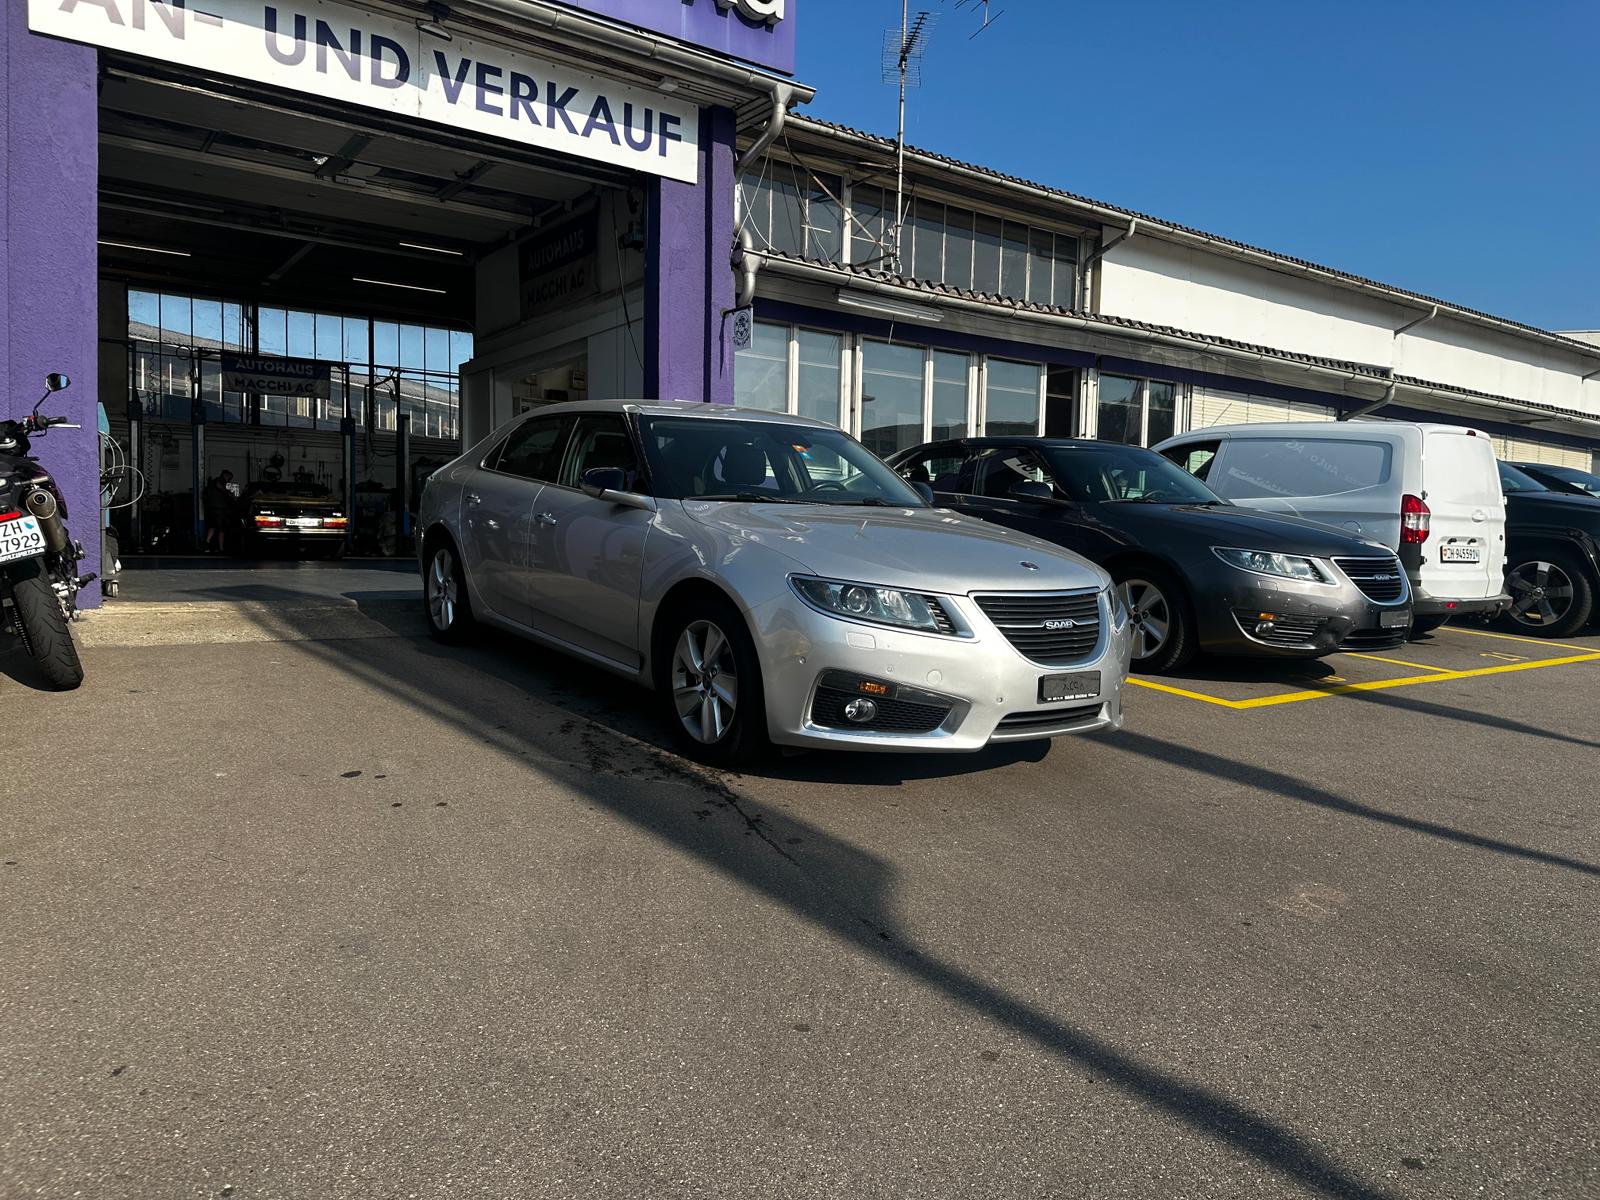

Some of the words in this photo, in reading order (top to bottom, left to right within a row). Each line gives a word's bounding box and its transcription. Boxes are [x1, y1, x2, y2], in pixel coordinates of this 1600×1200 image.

[264, 5, 411, 89] UND
[433, 49, 682, 158] VERKAUF
[527, 228, 585, 273] AUTOHAUS
[235, 358, 313, 376] AUTOHAUS
[234, 377, 291, 391] MACCHI
[0, 521, 22, 537] ZH
[0, 533, 40, 553] 7929
[1046, 619, 1073, 629] SAAB
